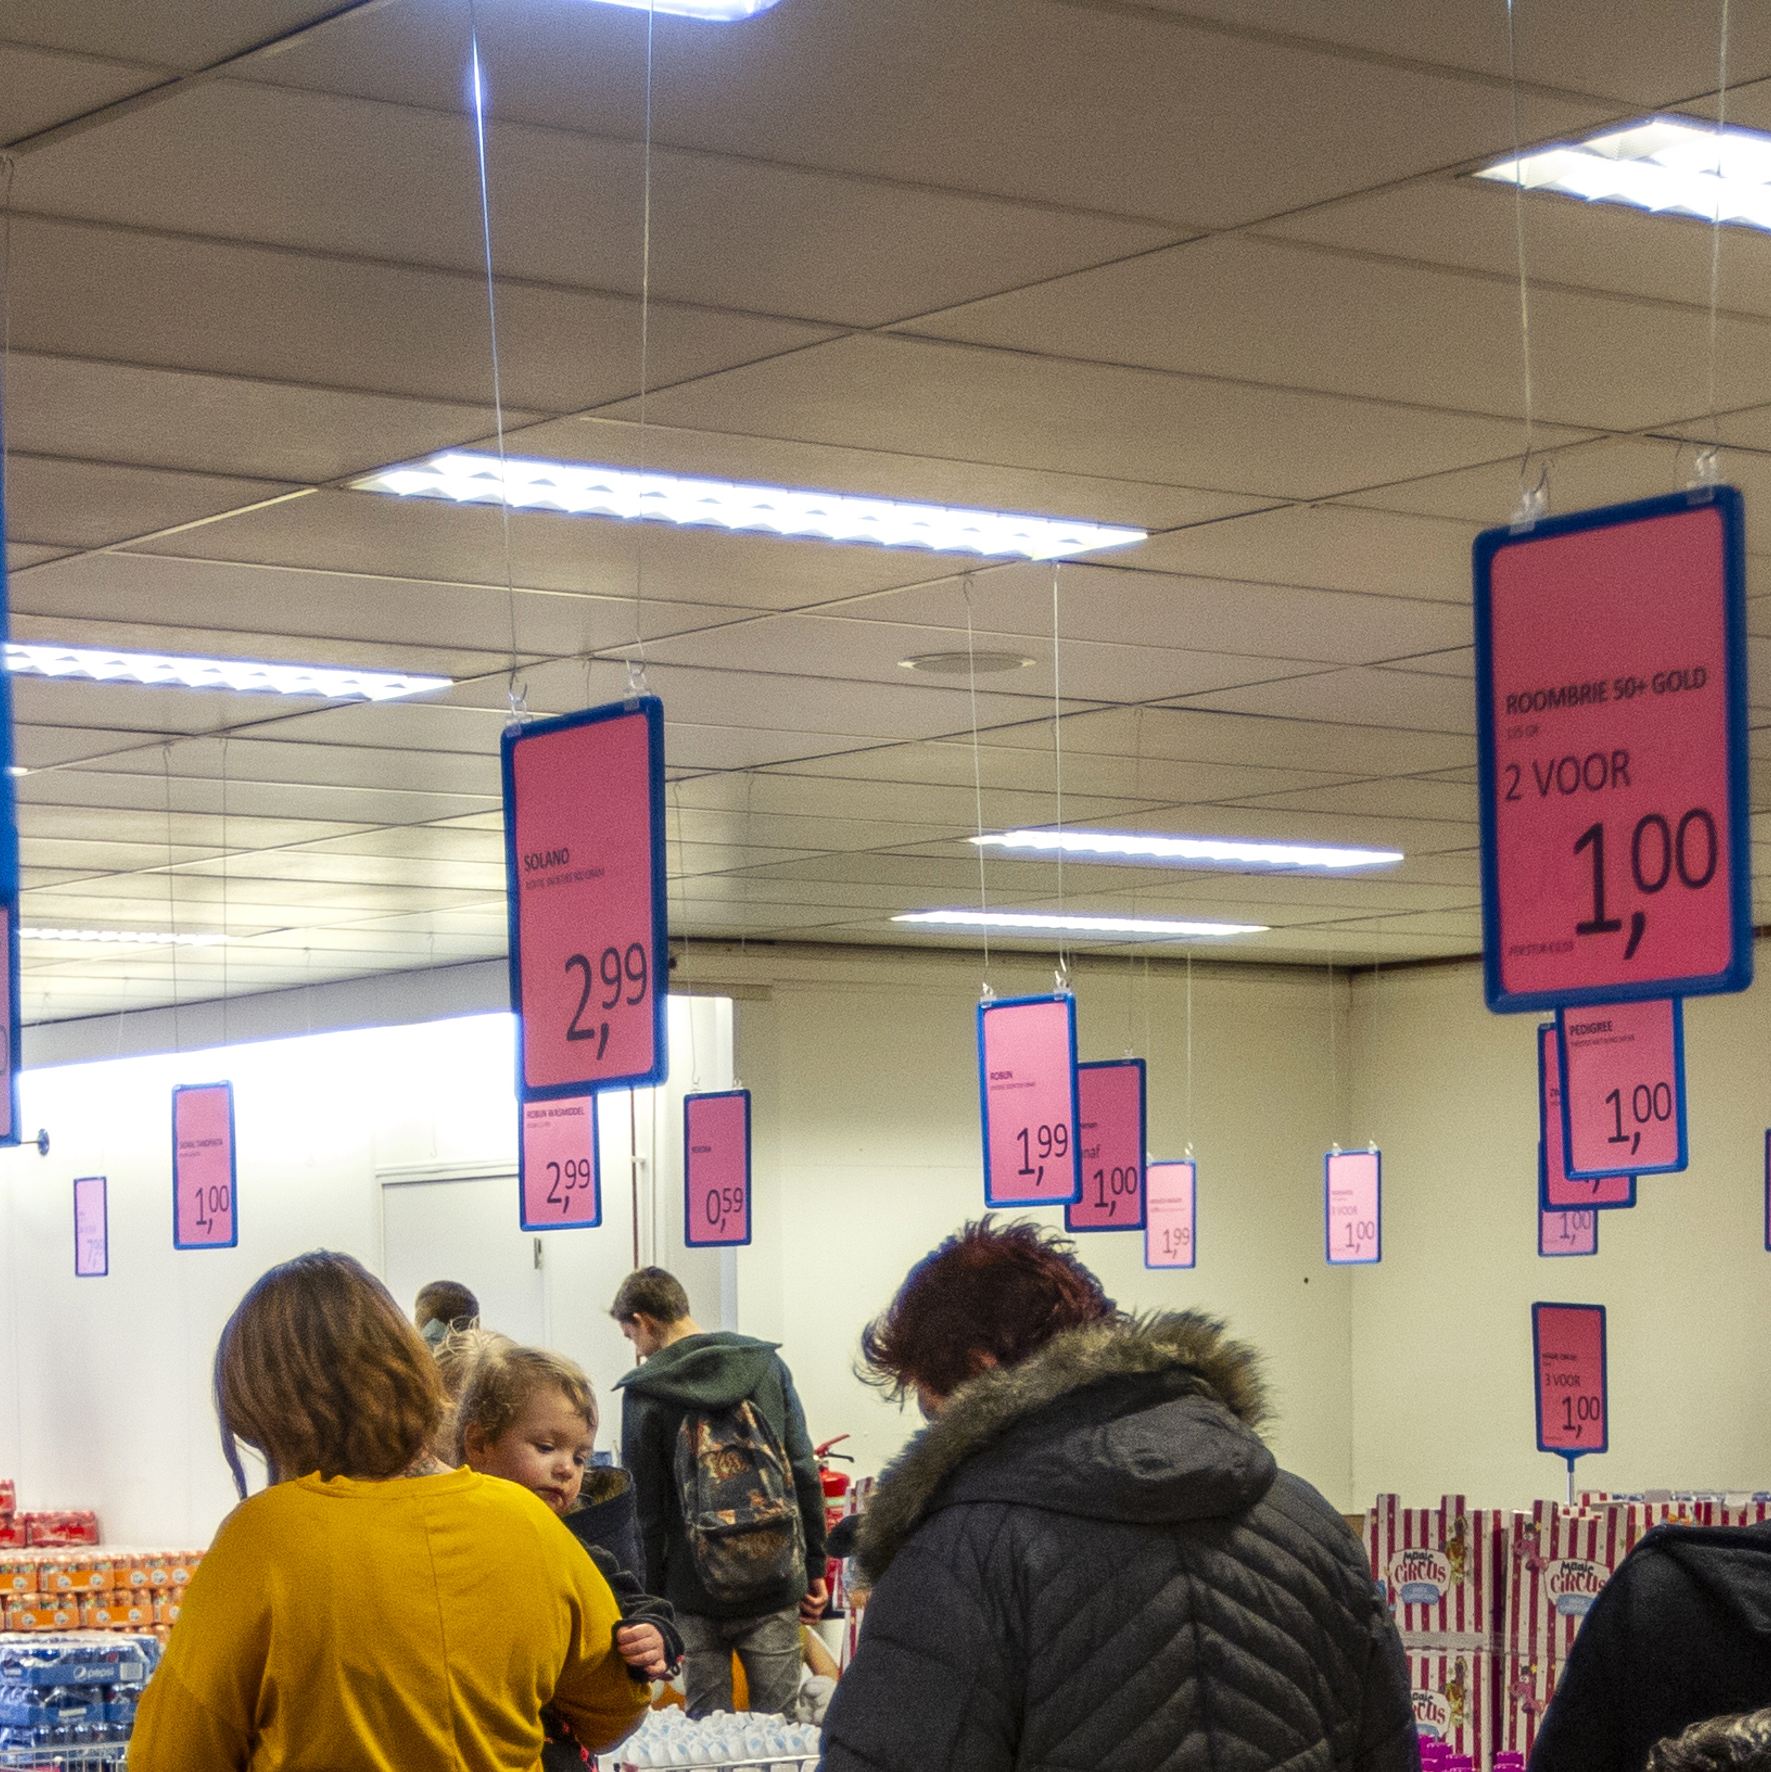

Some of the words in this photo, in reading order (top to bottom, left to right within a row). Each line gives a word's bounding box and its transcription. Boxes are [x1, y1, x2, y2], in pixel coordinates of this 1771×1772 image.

[1506, 680, 1608, 715] ROOMBRIE
[1613, 675, 1648, 701] 50+
[1651, 666, 1708, 695] GOLD
[1505, 763, 1521, 801] 2
[1532, 750, 1630, 797] VOOR
[524, 847, 570, 872] SOLANO
[1573, 808, 1718, 960] 1,00
[564, 942, 648, 1060] 2,99
[1569, 1020, 1613, 1036] PEDIGREE
[1605, 1082, 1671, 1155] 1,00
[1016, 1123, 1068, 1186] 1,99
[546, 1158, 590, 1213] 2,99
[1093, 1166, 1138, 1217] 1,00
[195, 1186, 229, 1234] 1,00
[706, 1187, 744, 1233] 0,59
[1162, 1227, 1191, 1259] 1,99
[1345, 1220, 1375, 1254] 1,00
[1552, 1373, 1581, 1388] VOOR
[1562, 1395, 1600, 1439] 1,00
[1403, 1551, 1434, 1564] Magic
[1561, 1561, 1595, 1574] Magic
[87, 1667, 115, 1678] pepsi
